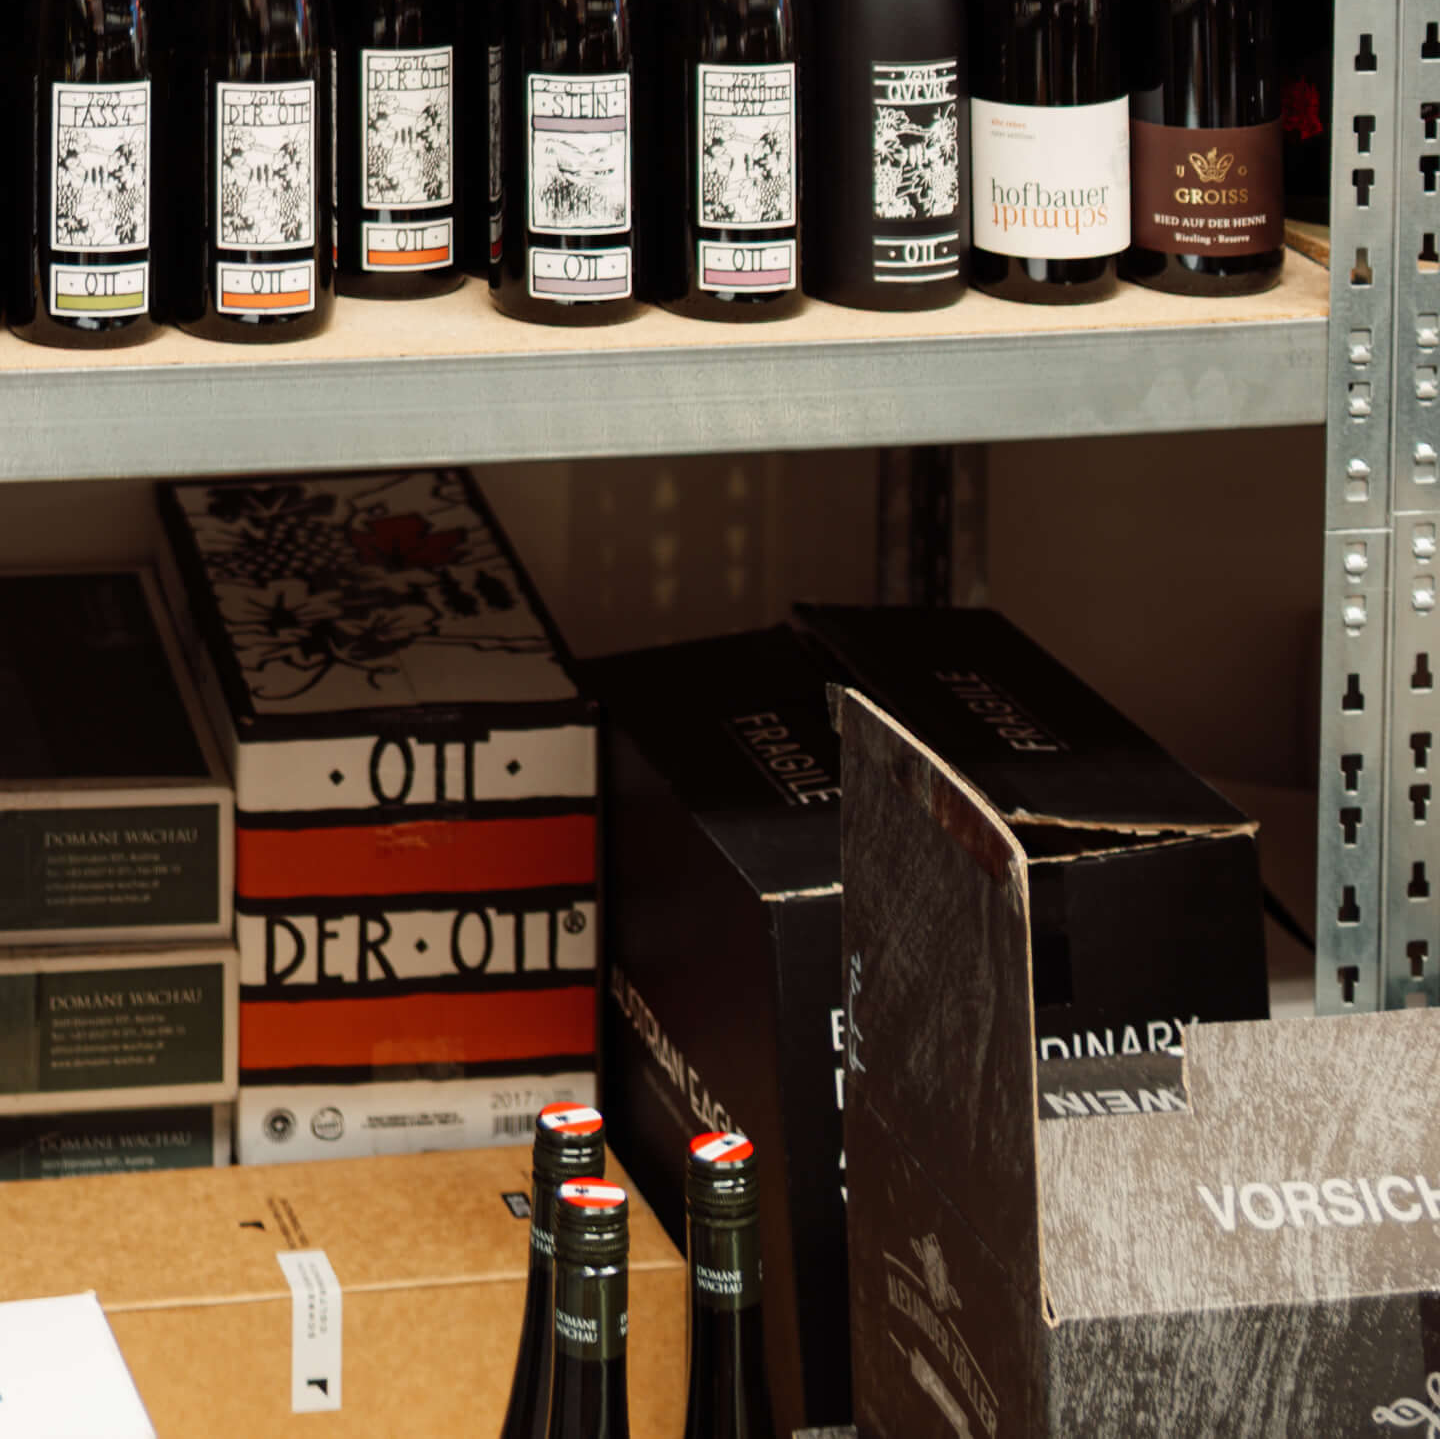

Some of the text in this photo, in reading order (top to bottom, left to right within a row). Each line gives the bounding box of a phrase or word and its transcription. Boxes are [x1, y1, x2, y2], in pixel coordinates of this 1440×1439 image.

[374, 69, 408, 90] DER
[551, 91, 608, 118] STEIN
[710, 86, 788, 101] GEMISCHTER
[228, 104, 264, 126] DER
[991, 177, 1109, 208] hofbauer
[1174, 187, 1249, 205] GROISS
[991, 203, 1109, 235] schmidt
[1153, 212, 1267, 229] RIED AUF DER HENNE
[395, 228, 428, 252] OTT
[1174, 232, 1250, 246] Riesling Reserve
[732, 248, 767, 272] OTT
[904, 240, 939, 264] OTT
[563, 255, 604, 281] OTT
[85, 272, 120, 296] OTT
[251, 270, 285, 294] OTT
[934, 668, 1059, 753] FRAGILE
[370, 732, 491, 806] OTT
[731, 711, 843, 804] FRAGILE
[44, 826, 198, 849] DOMÄNE WACHAU
[266, 914, 400, 986] DER
[49, 987, 202, 1012] DOMÄNE WACHAU
[491, 1091, 532, 1109] 2017
[1043, 1088, 1189, 1116] WEIN
[38, 1131, 192, 1153] DOMÄNE WACHAU
[696, 1264, 742, 1282] DOMÄNE
[697, 1277, 743, 1294] WACHAU
